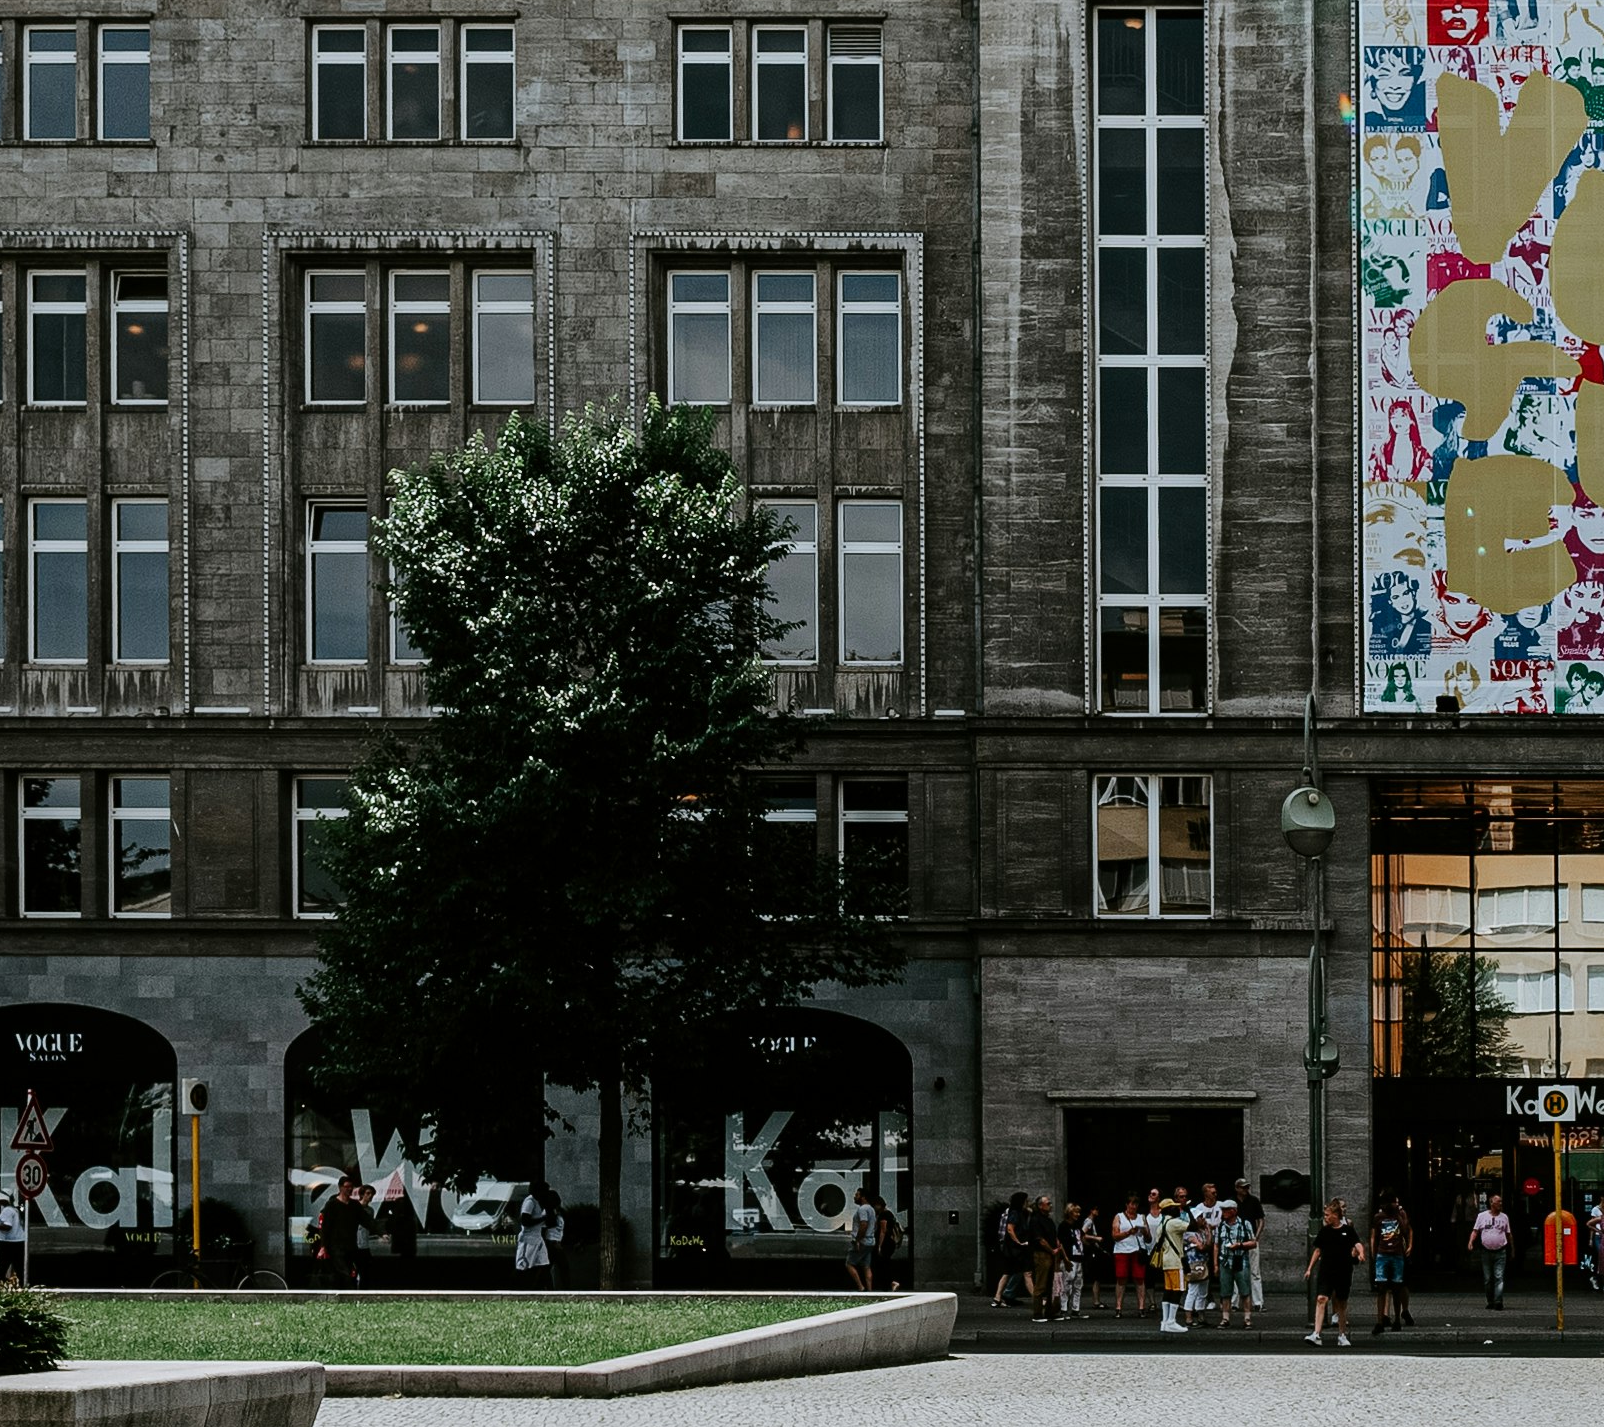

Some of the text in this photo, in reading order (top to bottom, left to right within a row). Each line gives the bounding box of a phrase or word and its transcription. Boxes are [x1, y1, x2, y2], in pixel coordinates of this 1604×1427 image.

[1364, 47, 1426, 65] VOGUE
[1491, 45, 1552, 65] VOGUE
[1363, 219, 1426, 237] VOGUE
[15, 1033, 83, 1052] VOGUE
[22, 1164, 42, 1186] 30
[125, 1232, 163, 1243] VOGUE
[669, 1235, 705, 1247] KaDeWe
